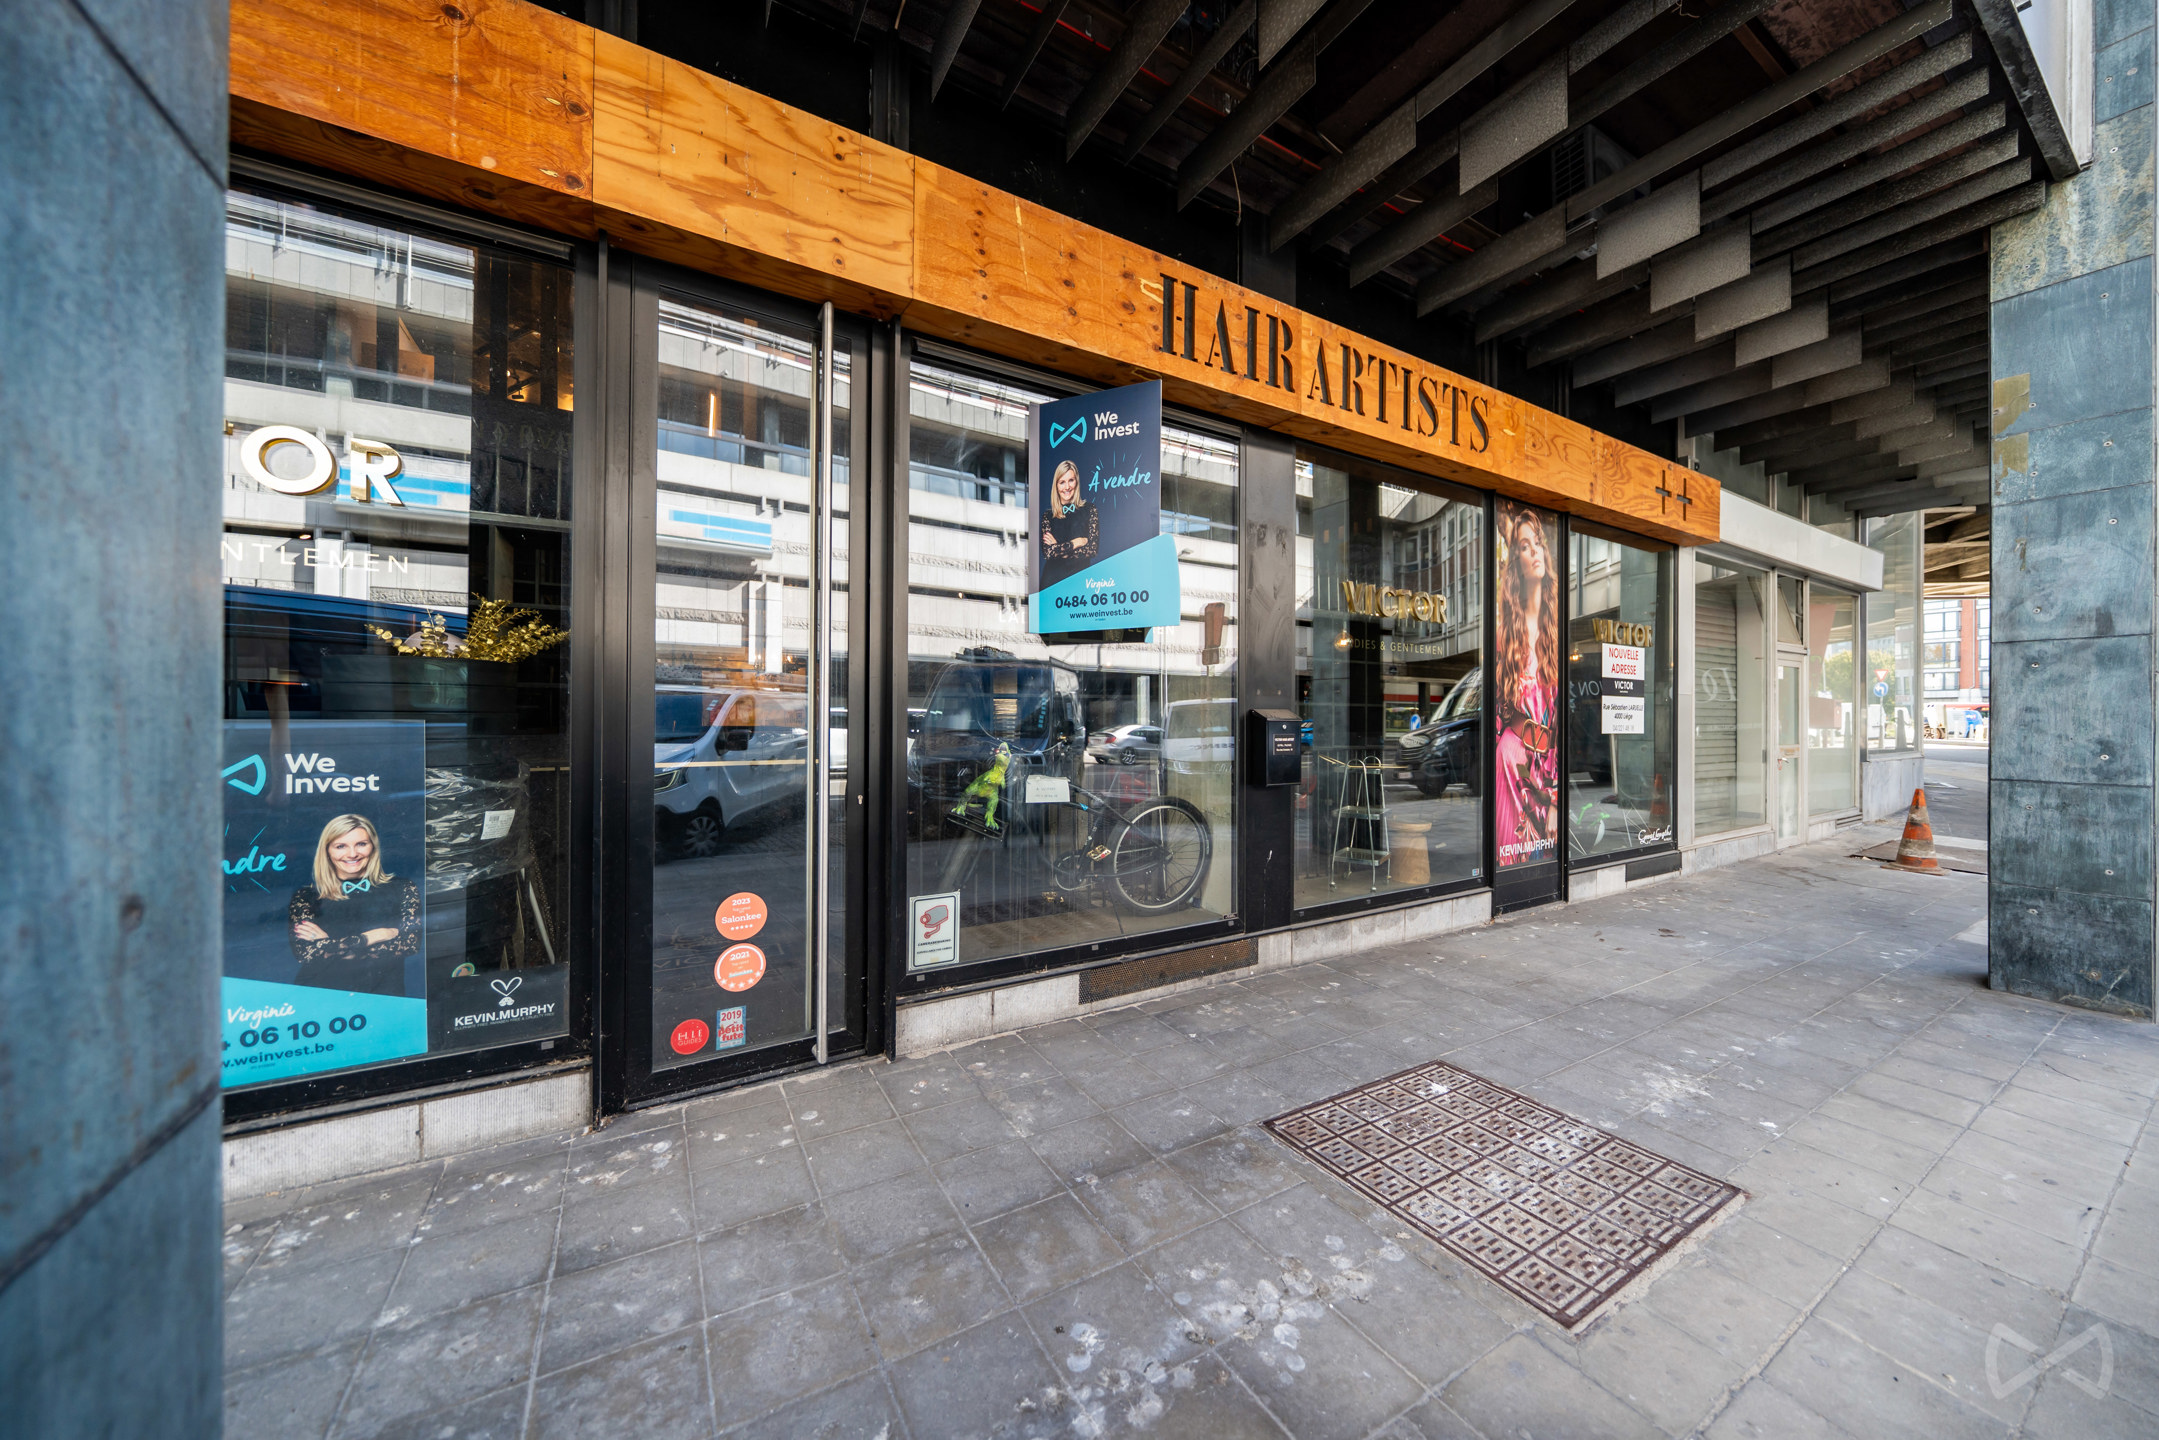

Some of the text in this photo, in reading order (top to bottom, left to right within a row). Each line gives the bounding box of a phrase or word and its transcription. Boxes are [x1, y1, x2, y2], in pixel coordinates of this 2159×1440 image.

[1160, 273, 1490, 453] HAIR ARTISTS
[1094, 411, 1119, 427] We
[1094, 421, 1140, 441] Invest
[224, 420, 406, 507] OR
[1103, 467, 1152, 490] vendre
[1085, 577, 1116, 594] Virginie
[1055, 589, 1150, 609] 0484 06 10 00
[1341, 580, 1449, 624] VICTOR
[1069, 607, 1134, 619] www.weinvest.be
[1390, 641, 1444, 656] GENTLEMEN
[1608, 647, 1639, 661] NOUVELLE
[1611, 663, 1637, 676] ADRESSE
[1613, 680, 1634, 690] VICTOR
[284, 753, 336, 774] We
[285, 774, 380, 795] Invest
[1499, 837, 1555, 857] KEVIN.MURPHY
[732, 897, 751, 906] 2023
[721, 913, 762, 924] Salonkee
[730, 951, 750, 961] 2021
[226, 1002, 296, 1029] Virginie
[454, 1002, 556, 1027] KEVIN.MURPHY
[720, 1010, 742, 1021] 2019
[239, 1026, 280, 1048] 06
[287, 1021, 321, 1041] 10
[328, 1013, 368, 1034] 00
[677, 1038, 703, 1047] GUIDES
